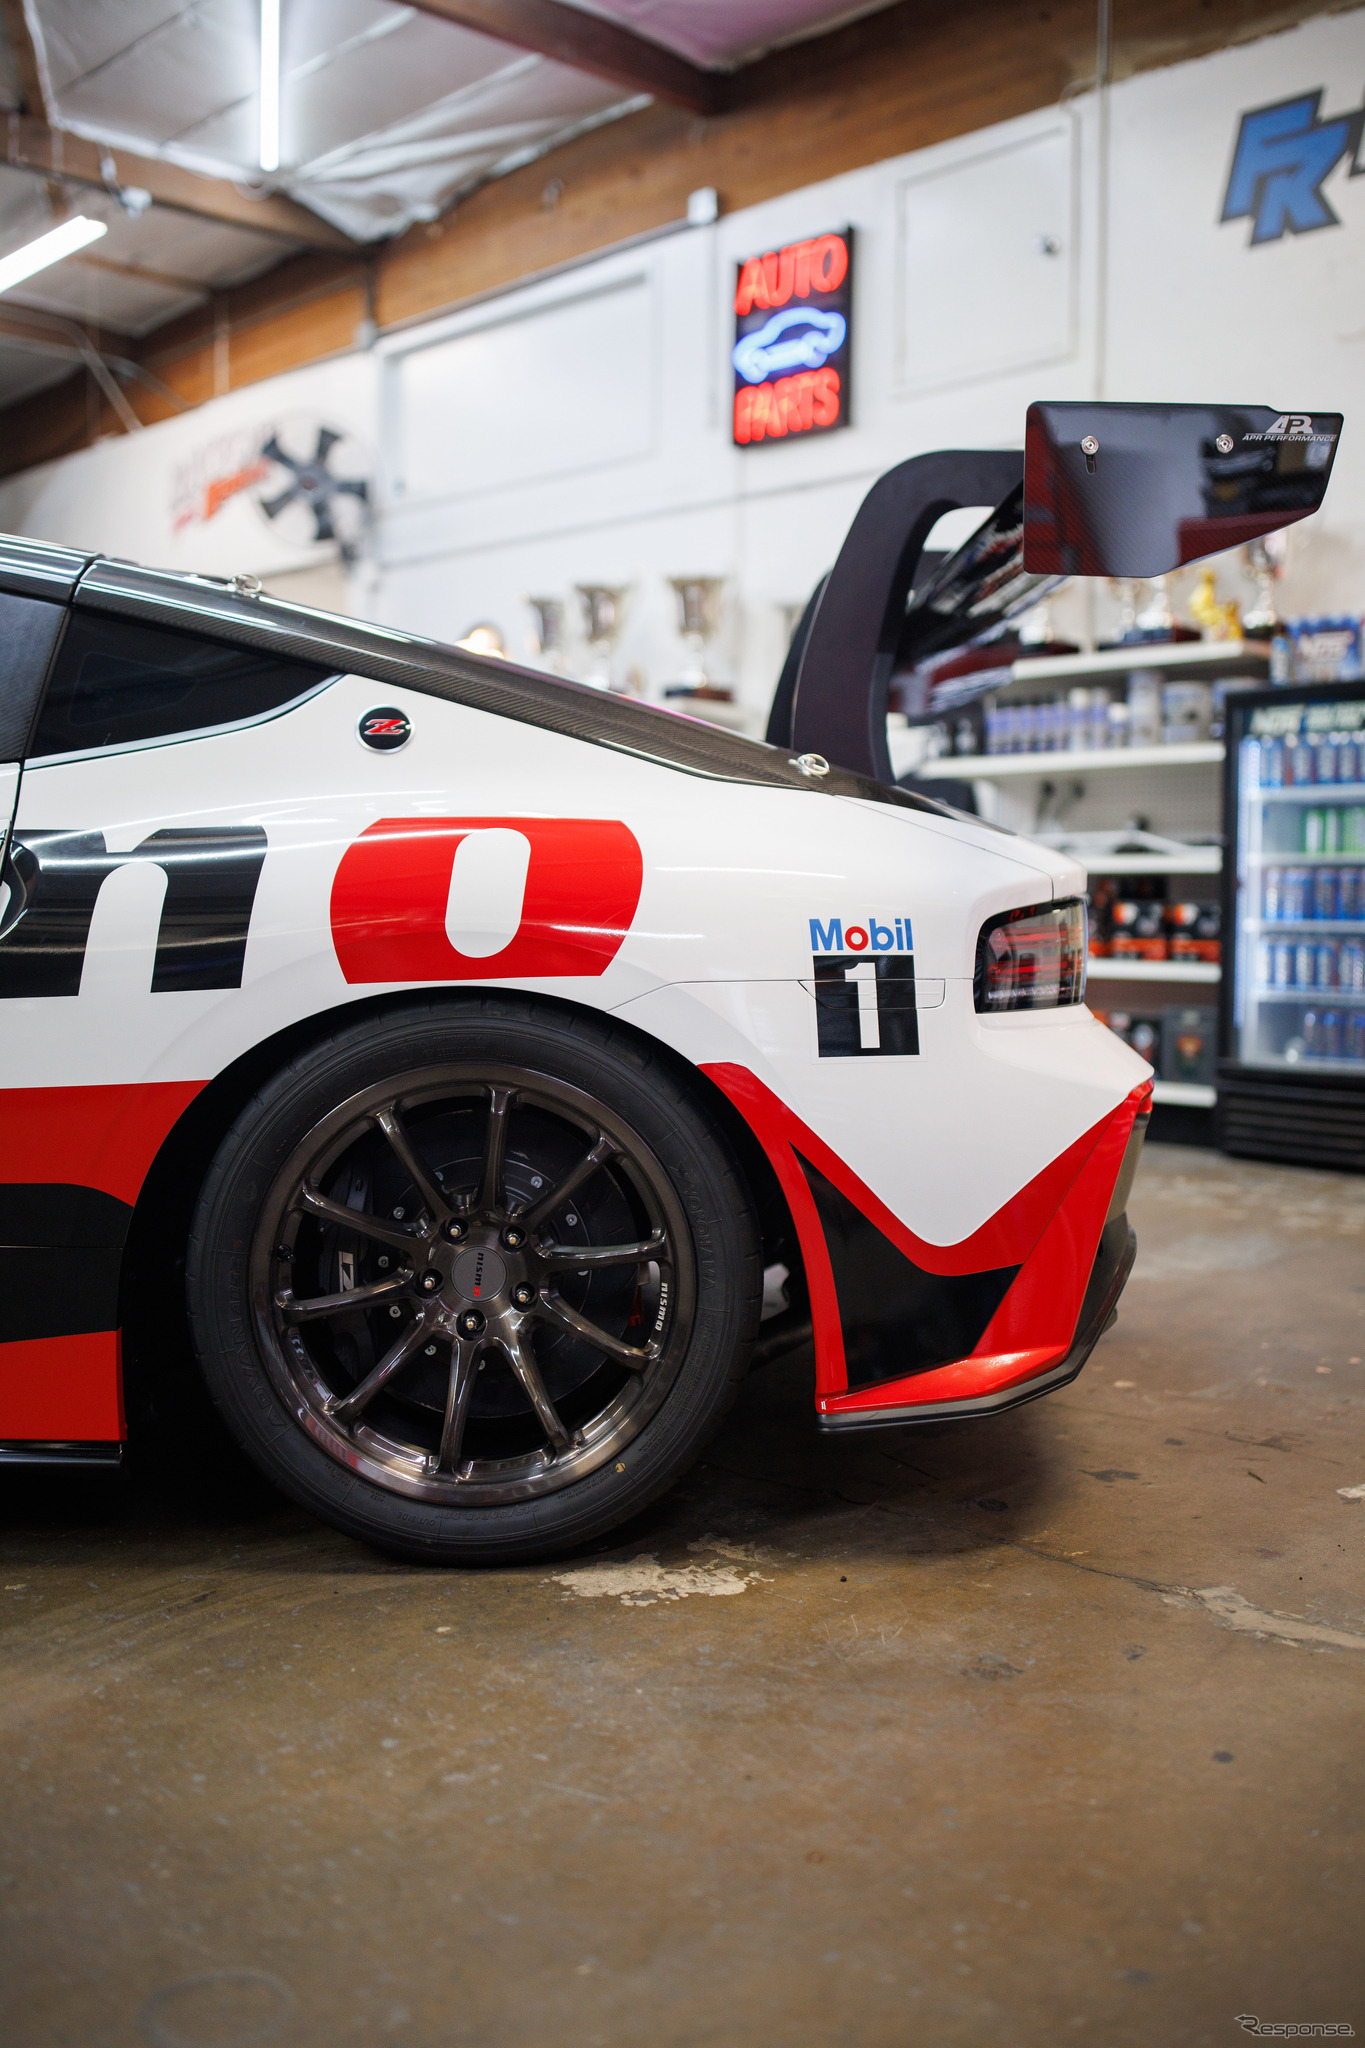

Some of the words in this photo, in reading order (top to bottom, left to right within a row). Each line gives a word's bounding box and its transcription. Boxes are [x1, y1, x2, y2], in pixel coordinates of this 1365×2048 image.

[734, 234, 848, 315] AUTO
[734, 367, 840, 444] PARTS
[1242, 433, 1263, 441] APR
[1264, 434, 1337, 442] PERFORMANCE
[364, 718, 407, 735] Z
[809, 918, 914, 951] Mobil
[844, 962, 881, 1049] 1
[688, 1184, 716, 1291] YOKOHAMA
[473, 1252, 485, 1297] nismo
[654, 1282, 668, 1331] nismo
[231, 1318, 285, 1427] ADVAN
